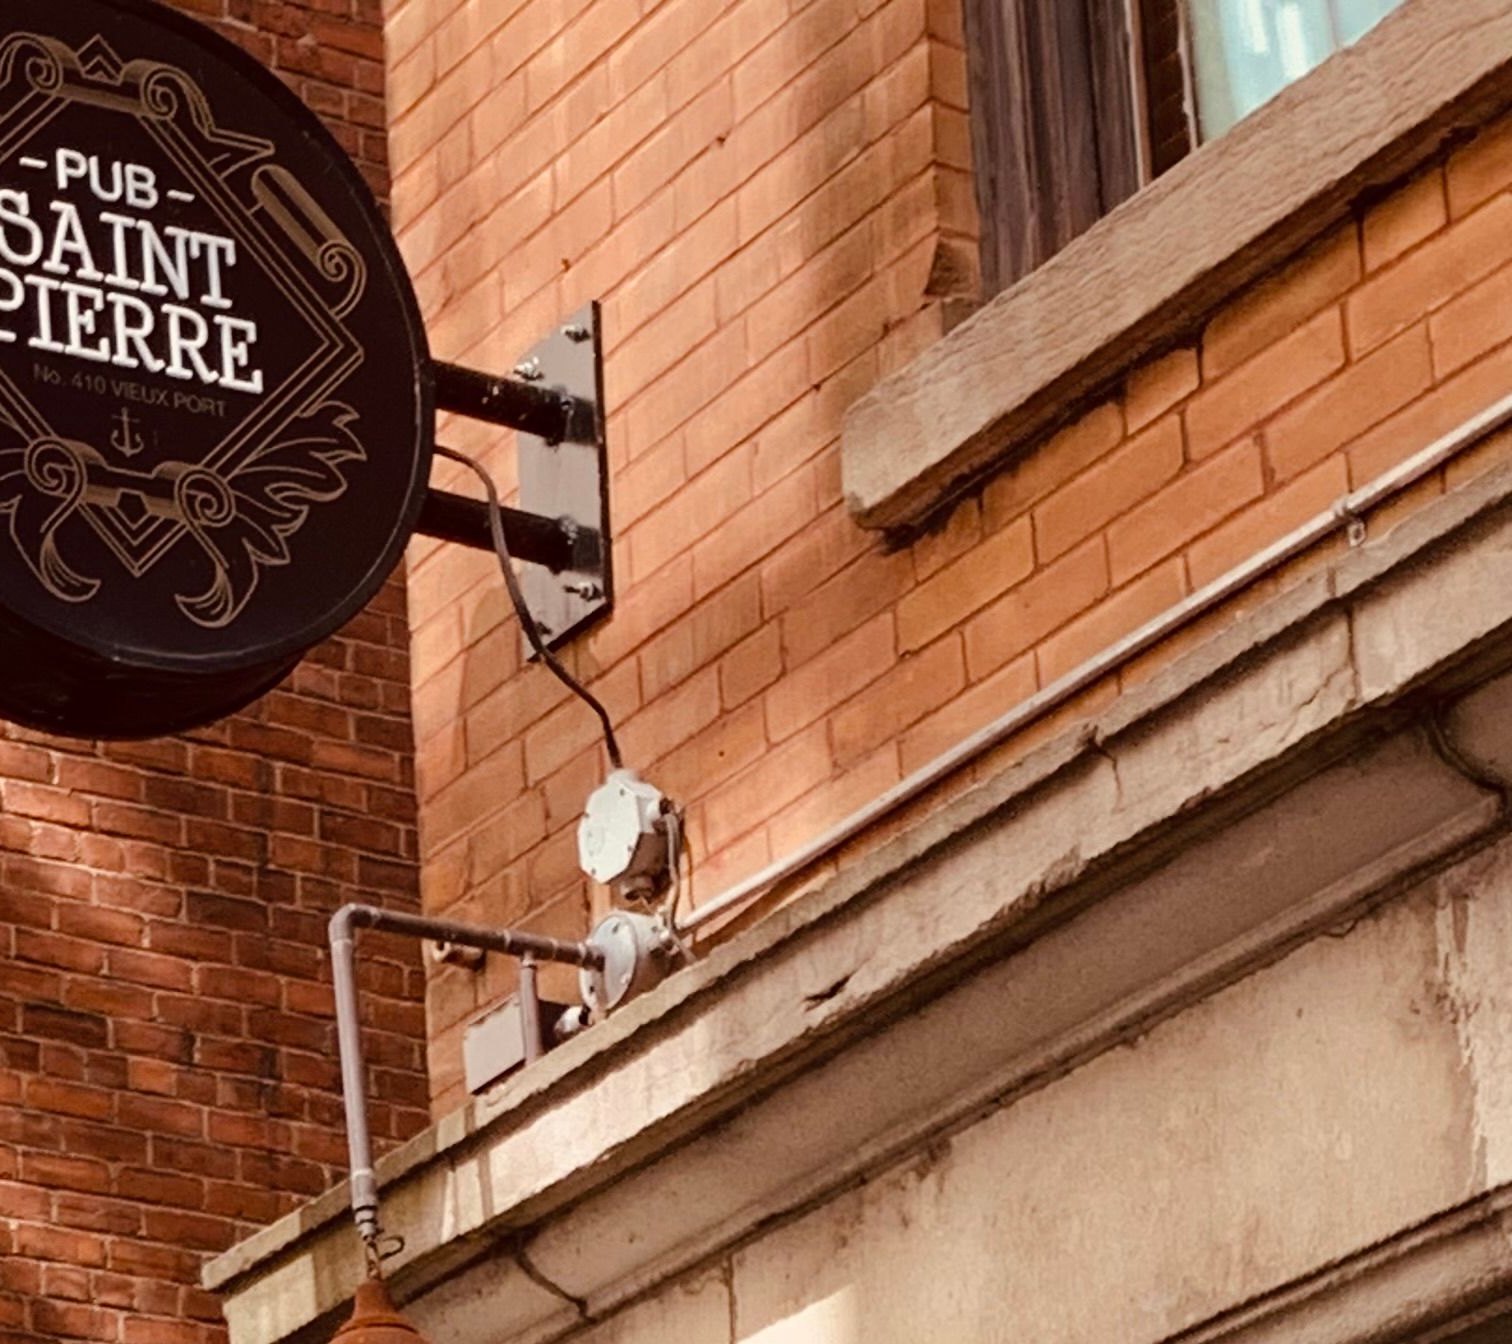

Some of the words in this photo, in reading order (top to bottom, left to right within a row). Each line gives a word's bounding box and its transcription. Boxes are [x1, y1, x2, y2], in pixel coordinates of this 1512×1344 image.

[55, 148, 159, 209] PUB
[72, 371, 107, 394] 410
[111, 378, 170, 406] VIEUX
[173, 391, 228, 417] PORT
